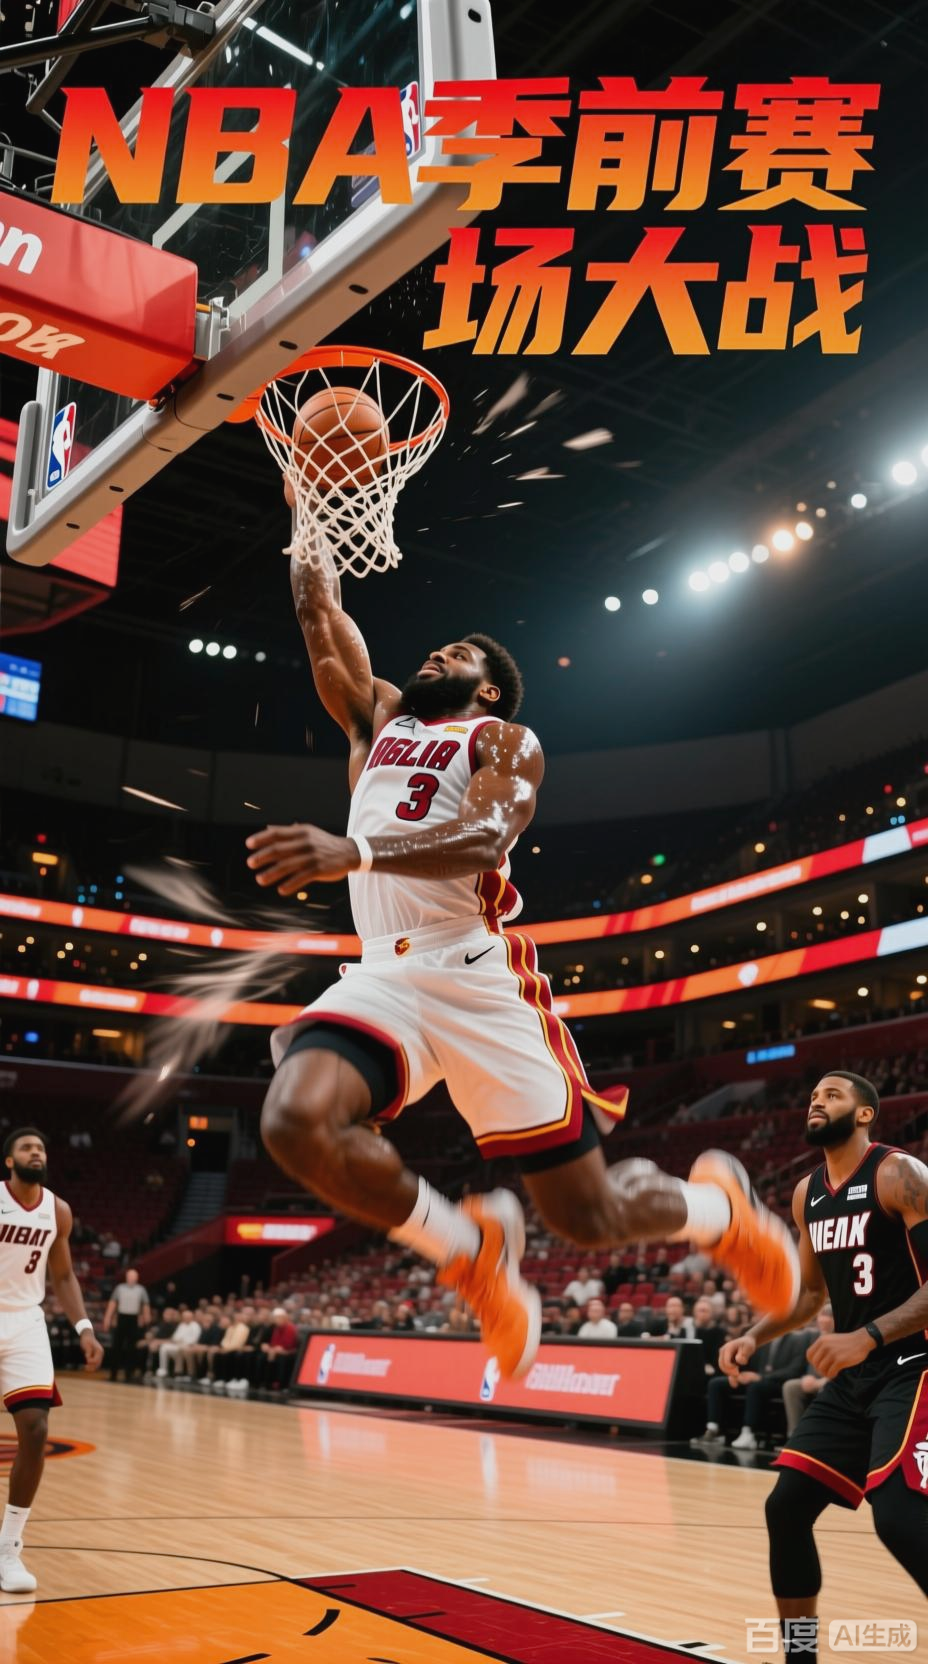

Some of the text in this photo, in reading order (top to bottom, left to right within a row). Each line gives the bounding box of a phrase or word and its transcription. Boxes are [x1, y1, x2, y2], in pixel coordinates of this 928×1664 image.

[395, 773, 440, 821] 3
[24, 1250, 42, 1274] 3
[852, 1253, 873, 1295] 3
